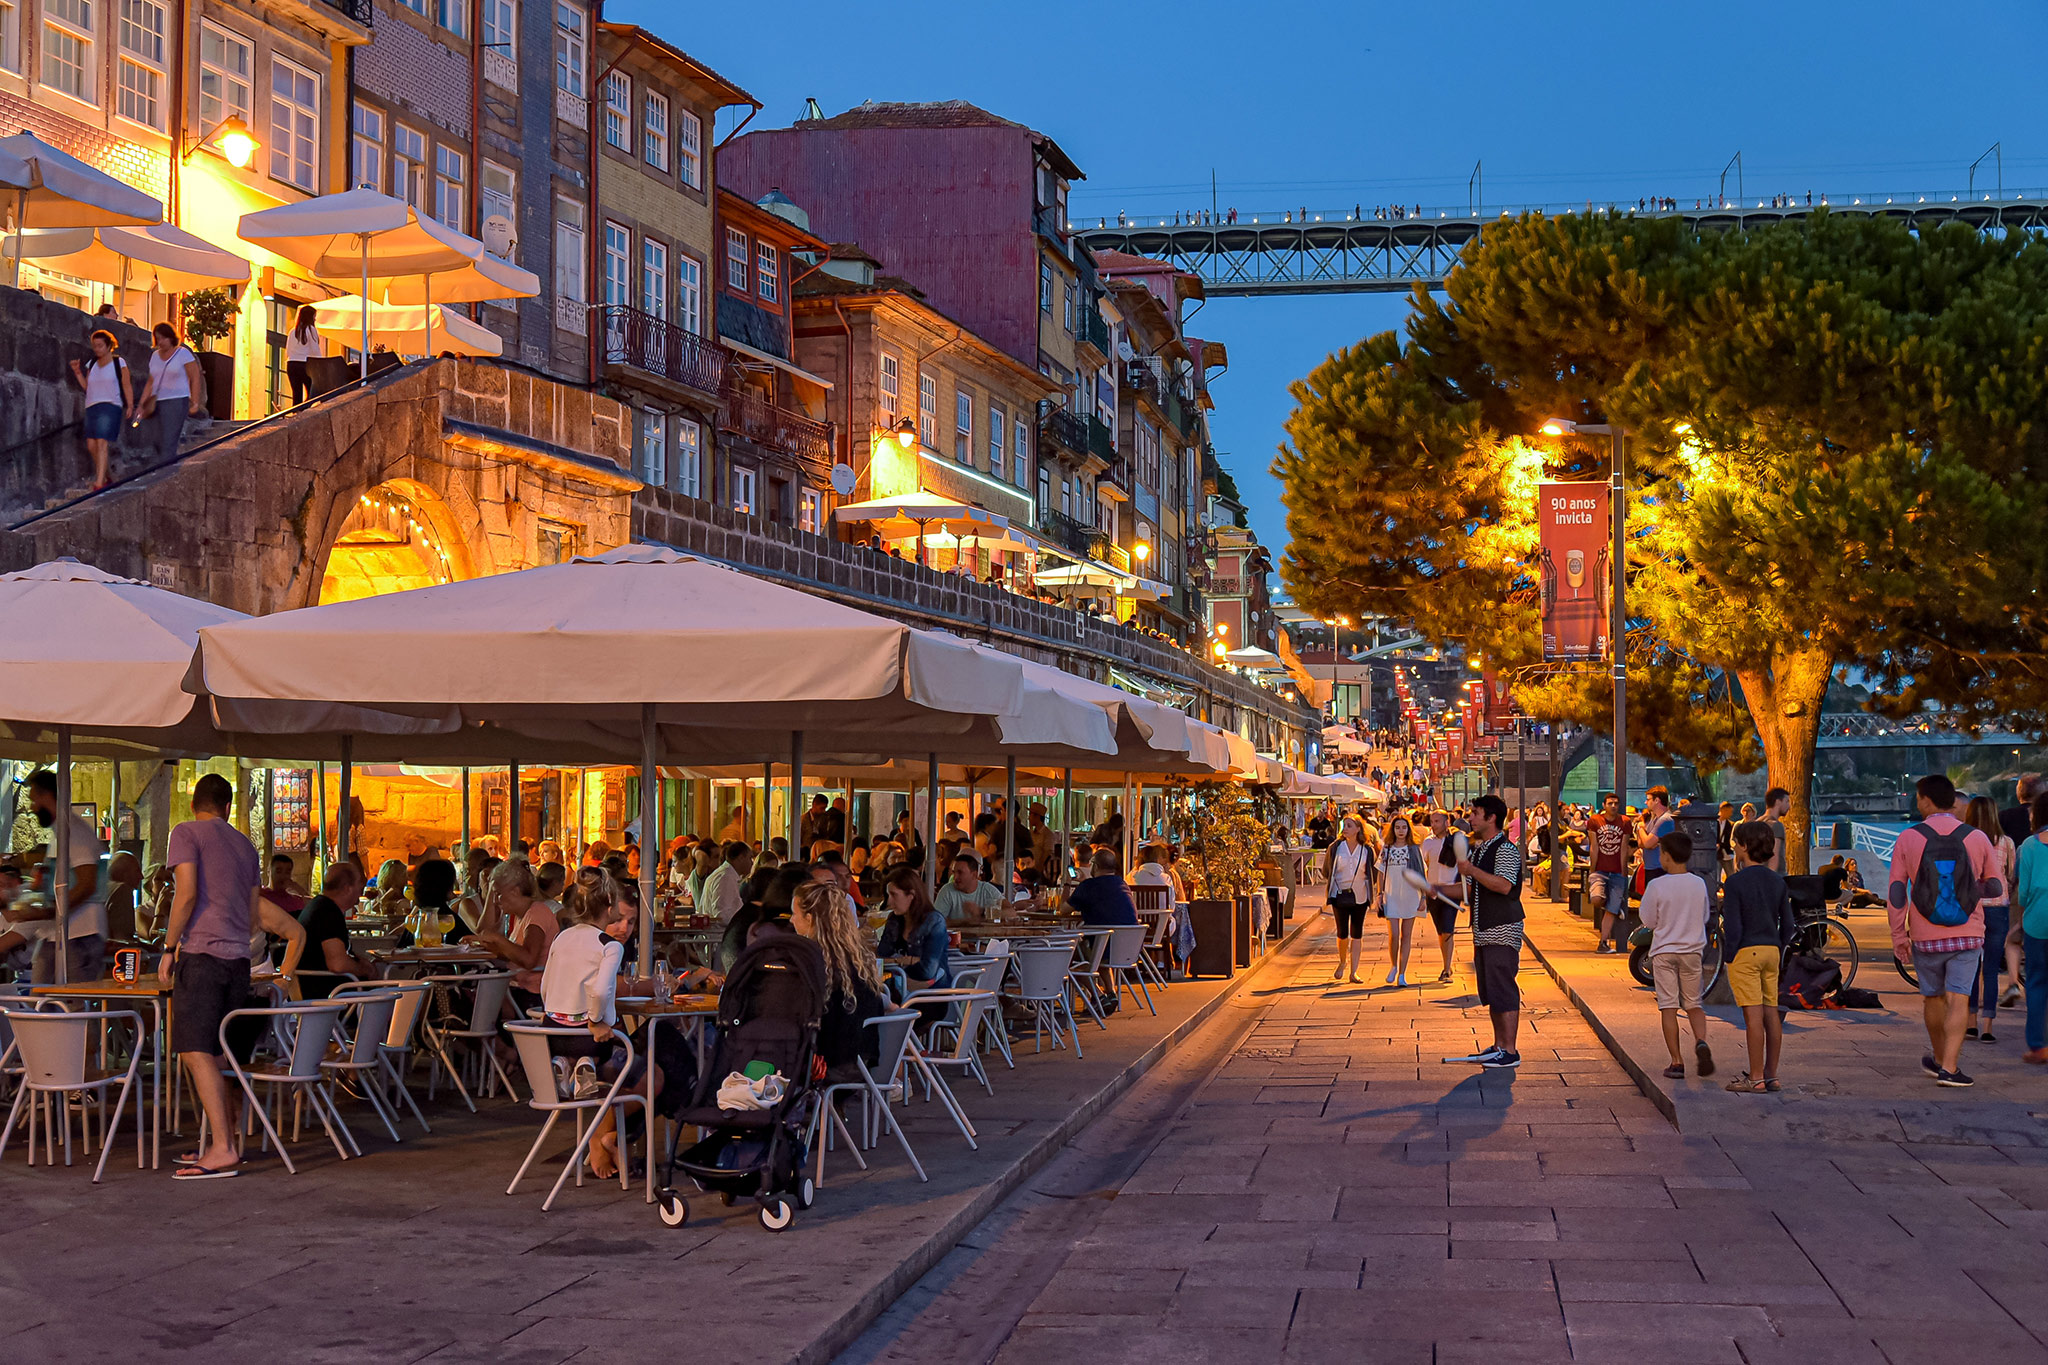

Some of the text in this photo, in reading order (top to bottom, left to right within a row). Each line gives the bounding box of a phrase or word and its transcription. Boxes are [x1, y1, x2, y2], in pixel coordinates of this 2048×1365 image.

[1551, 497, 1596, 511] 90 anos
[1555, 511, 1593, 525] invicta
[125, 953, 135, 980] BOGANI
